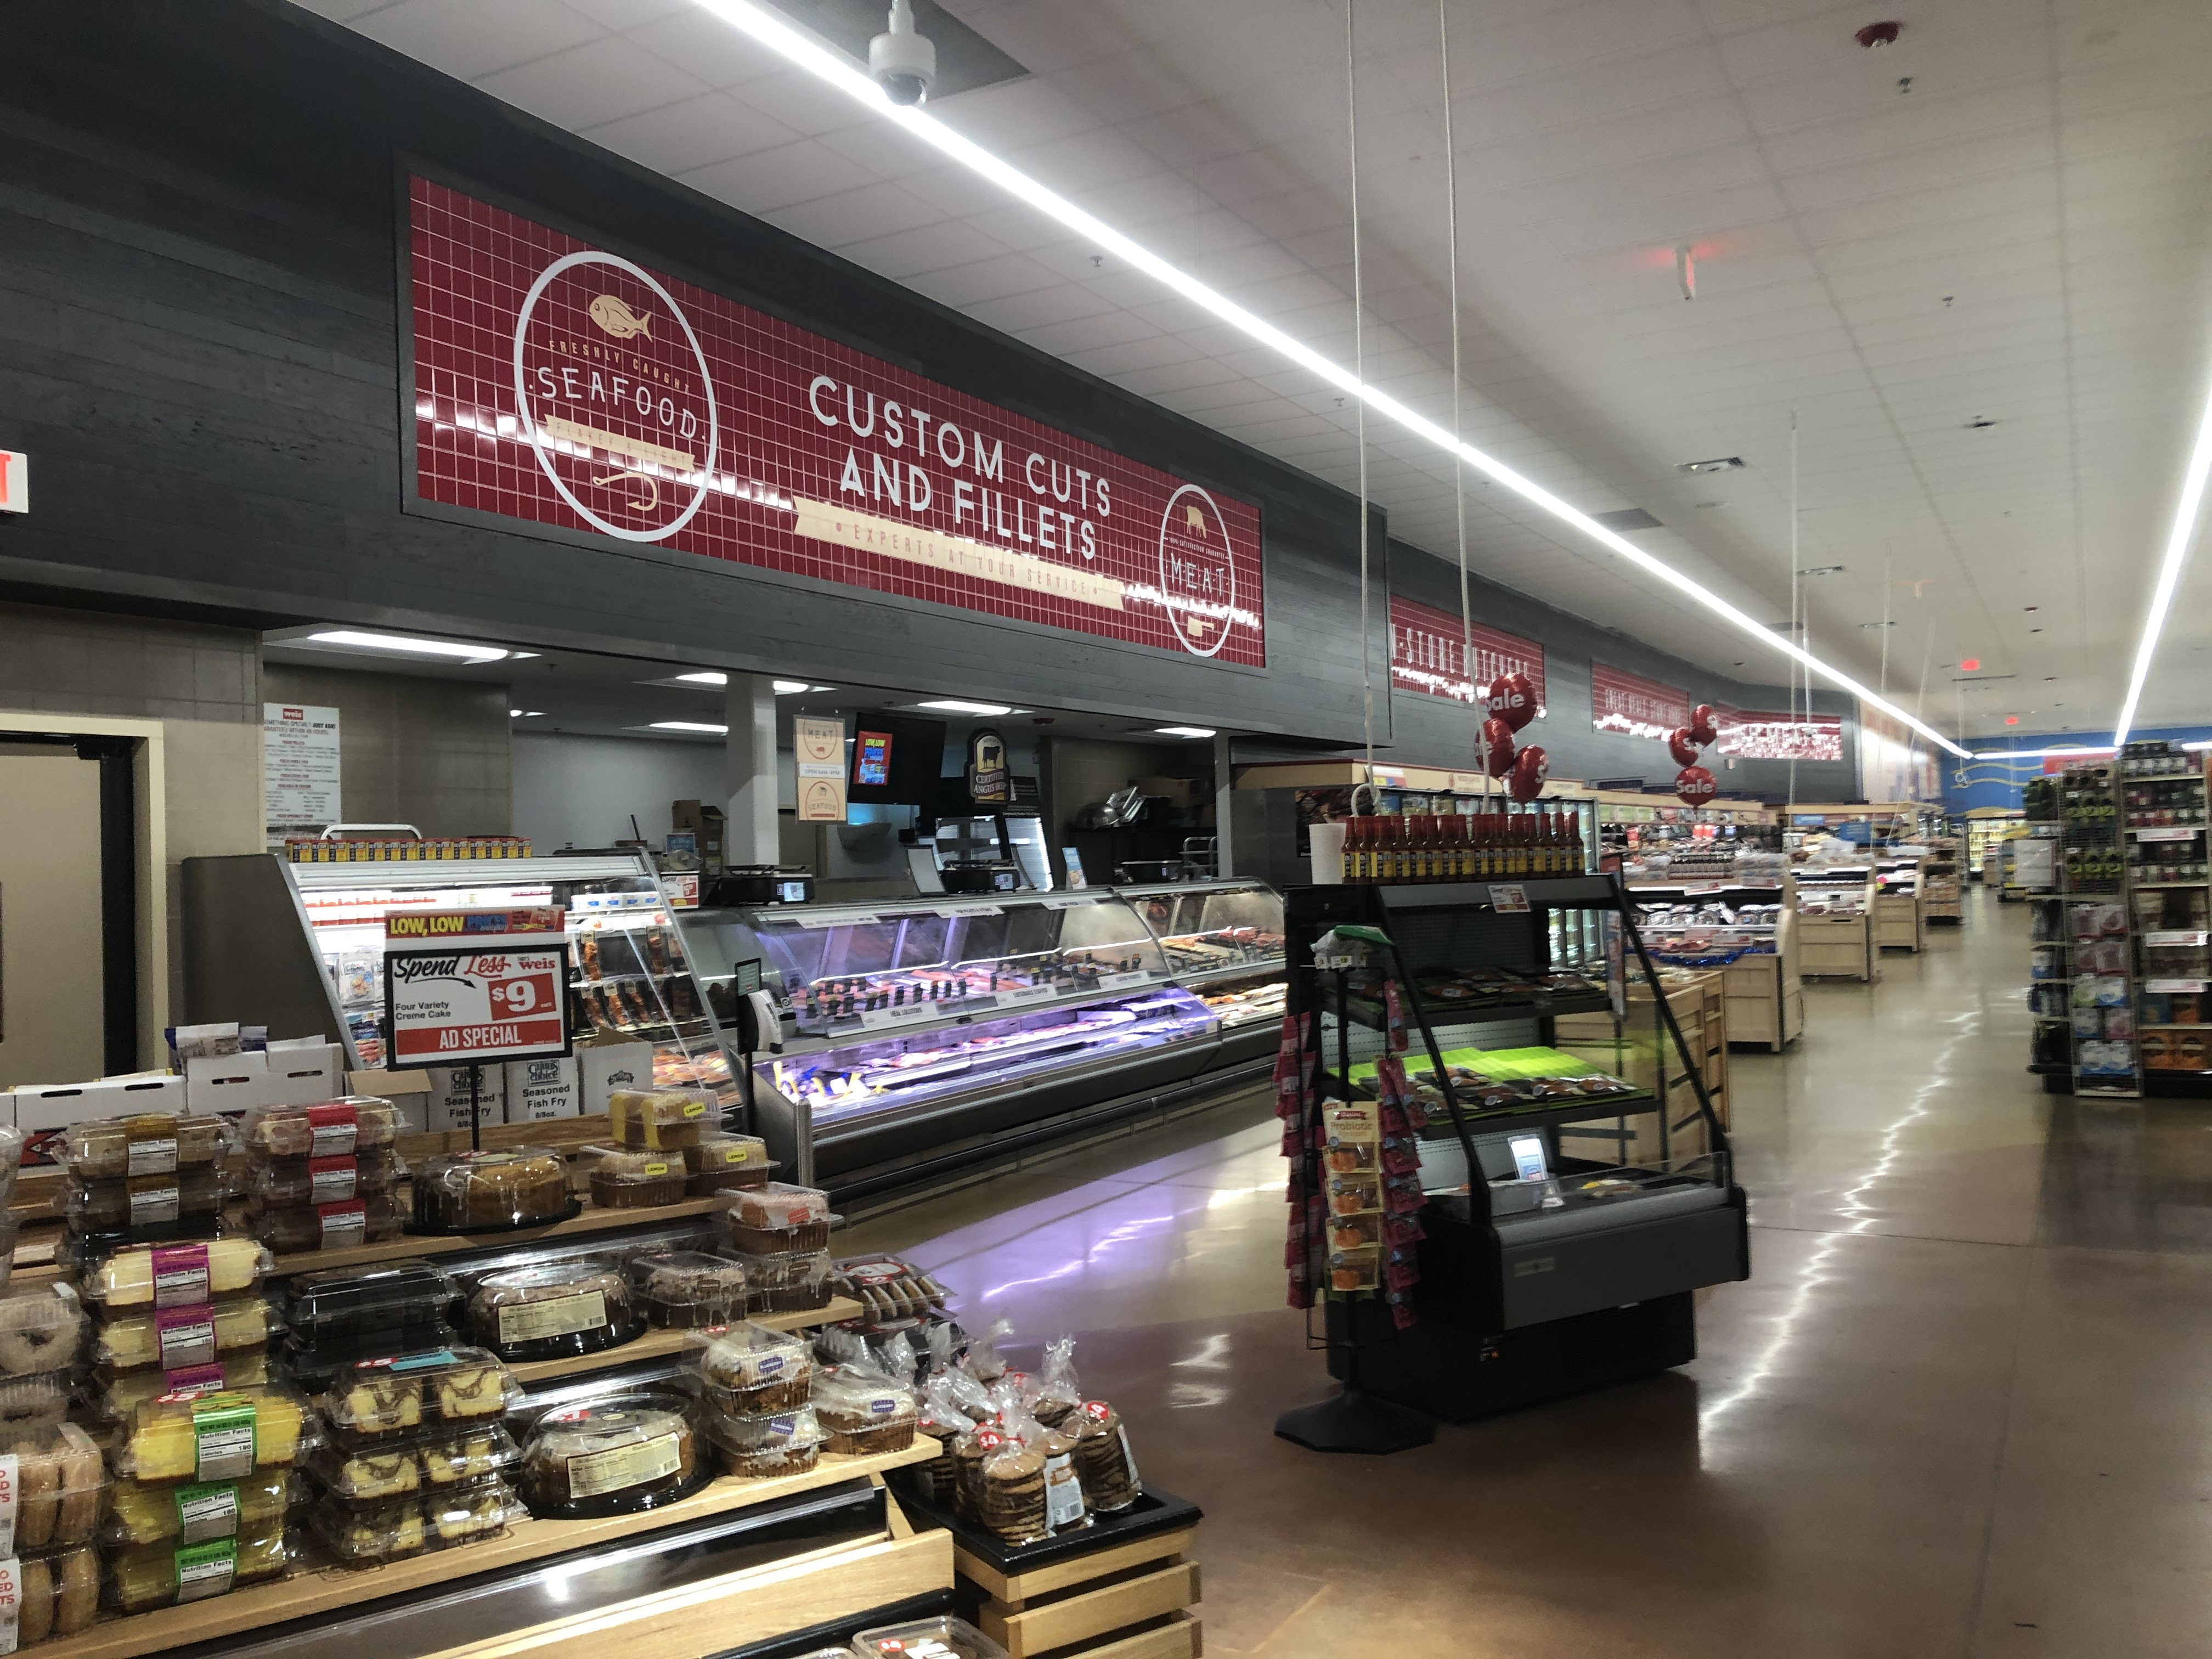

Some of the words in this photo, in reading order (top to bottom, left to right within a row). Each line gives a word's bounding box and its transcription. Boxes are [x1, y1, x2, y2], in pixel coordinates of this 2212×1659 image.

[549, 340, 619, 364] FRESHLY
[633, 358, 689, 393] CAUGHT
[538, 367, 697, 438] SEAFOOD
[809, 375, 1003, 483] CUSTOM
[1026, 453, 1110, 517] CUTS
[839, 446, 931, 511] AND
[954, 479, 1096, 560] FILLETS
[854, 524, 934, 558] EXPERTS
[949, 549, 963, 565] AT
[978, 555, 1015, 578] YOUR
[1027, 568, 1085, 599] SERVICE
[1171, 552, 1224, 597] MEAT
[1390, 623, 1454, 674] N-STORE
[808, 729, 833, 740] MEAT
[975, 772, 1004, 784] CERTIFIED
[973, 783, 995, 794] ANGUS
[1677, 778, 1713, 794] Sale
[808, 803, 836, 811] SEAFOOD
[390, 917, 428, 936] LOW,
[430, 916, 464, 933] LOW
[394, 955, 461, 984] Spend
[464, 955, 511, 978] Less
[519, 957, 555, 970] weis
[492, 980, 536, 1012] $9
[395, 1003, 416, 1011] Four
[419, 1001, 449, 1009] Variety
[396, 1012, 425, 1020] Creme
[428, 1011, 451, 1019] Cake
[439, 1029, 459, 1049] AD
[462, 1025, 522, 1048] SPECIAL
[522, 1084, 570, 1097] Seasoned
[444, 1094, 495, 1107] Seasned
[527, 1098, 548, 1109] Fish
[551, 1097, 567, 1107] Fry
[449, 1108, 471, 1118] Fish
[686, 1105, 702, 1114] LEMON
[157, 1272, 185, 1280] Nutrition
[162, 1326, 190, 1335] Nutrition
[193, 1323, 210, 1331] Facts
[173, 1384, 201, 1393] Nutrition
[980, 1435, 1001, 1447] $4
[183, 1498, 212, 1509] Nutrition
[215, 1492, 233, 1500] Facts
[181, 1564, 211, 1573] Nutrition
